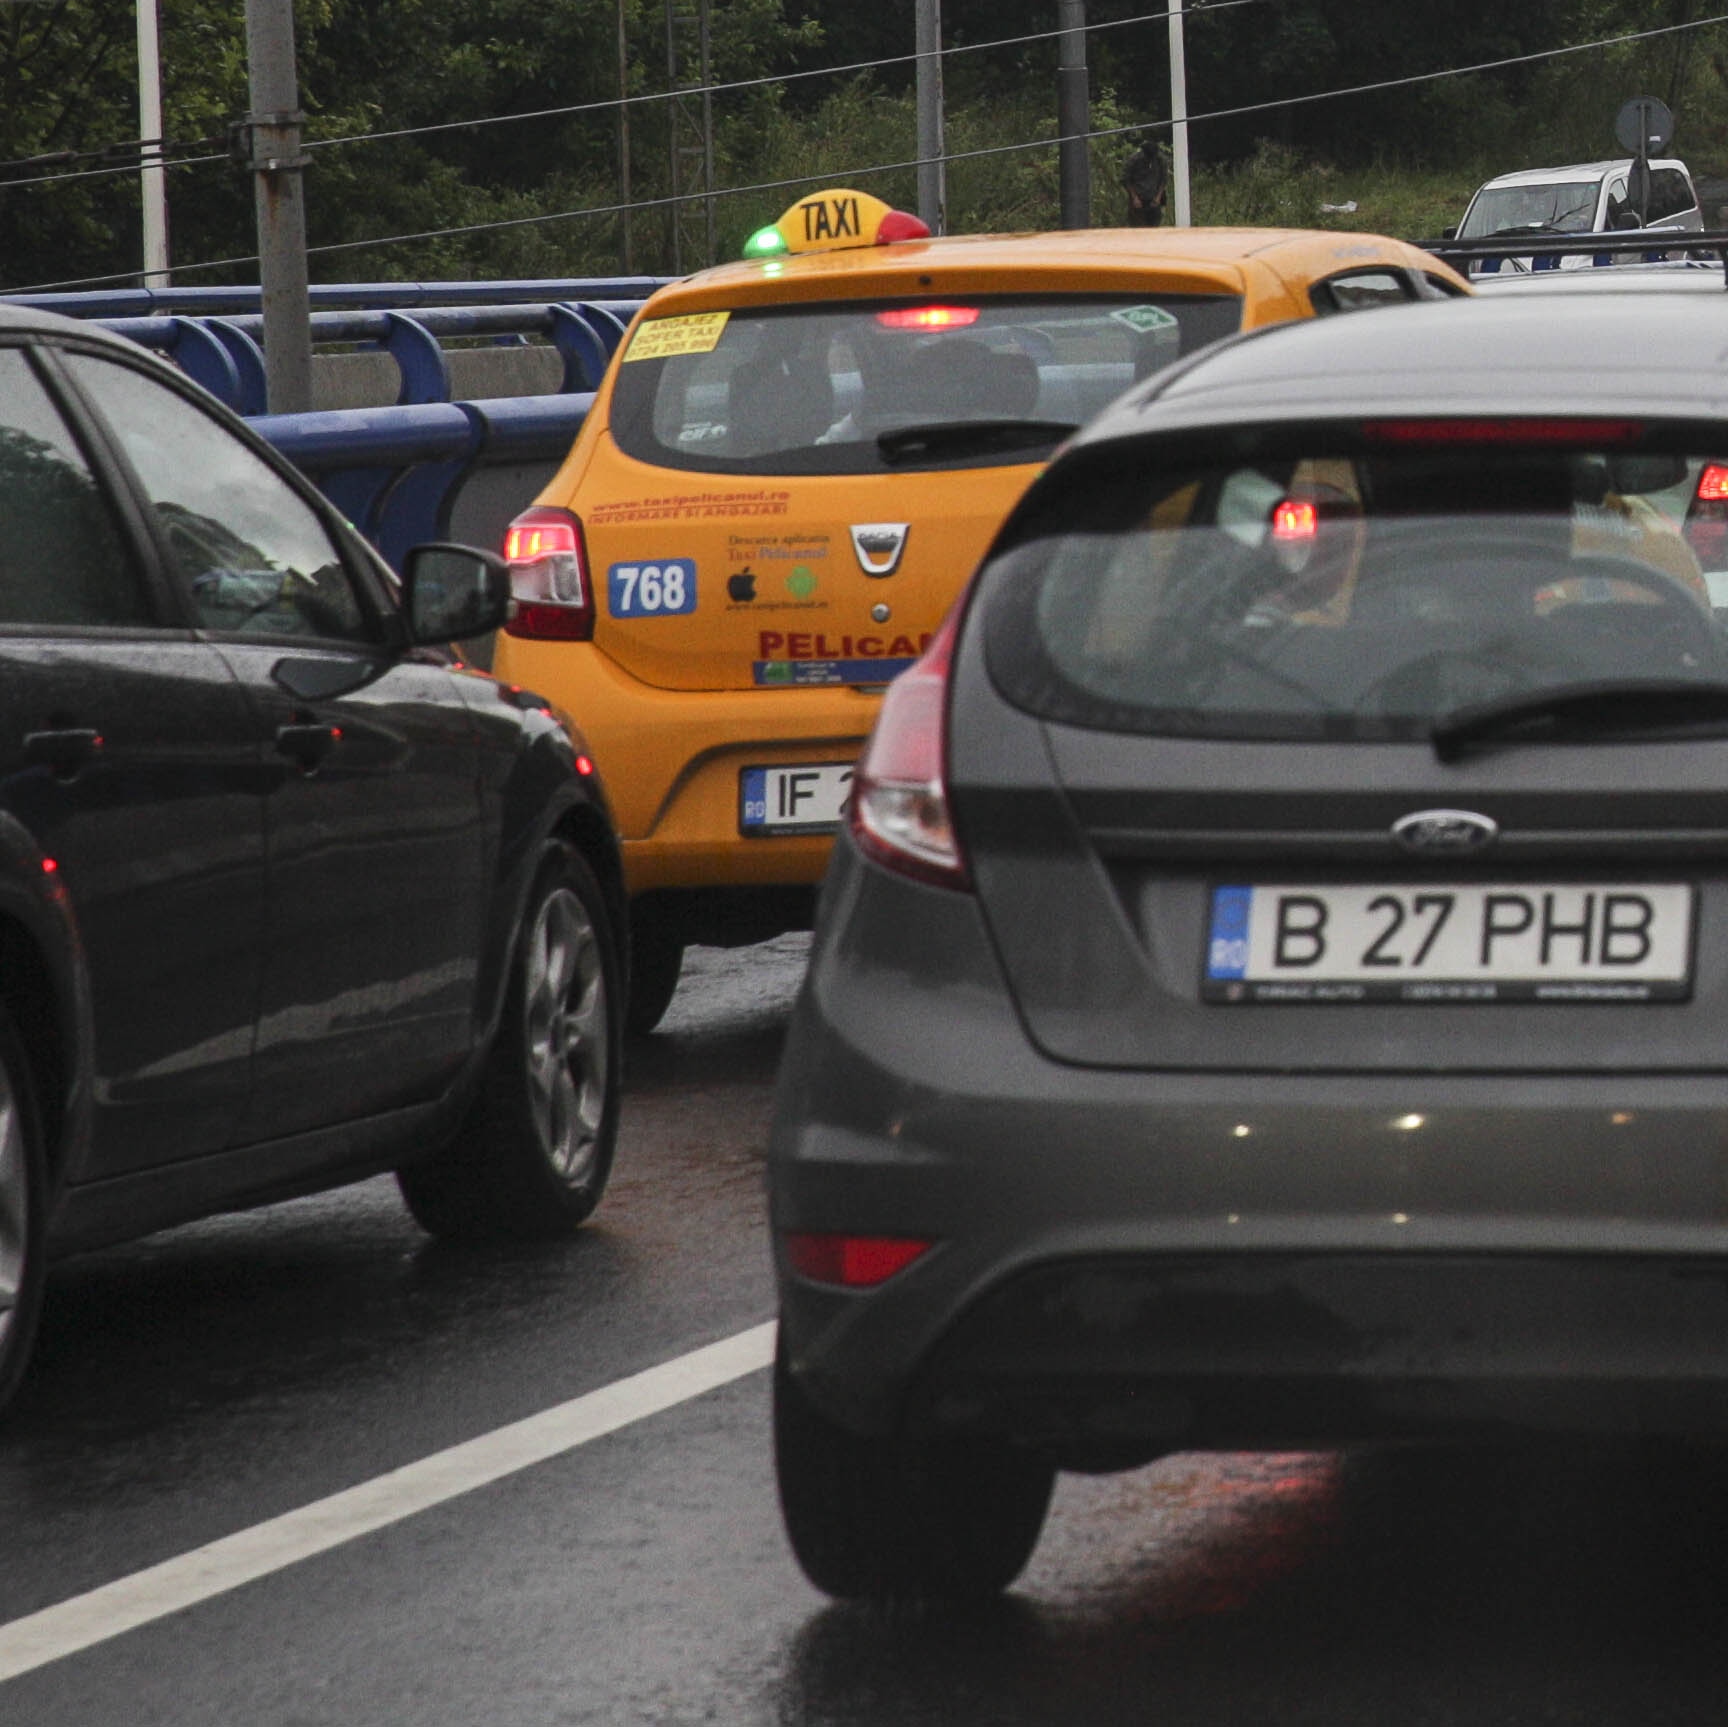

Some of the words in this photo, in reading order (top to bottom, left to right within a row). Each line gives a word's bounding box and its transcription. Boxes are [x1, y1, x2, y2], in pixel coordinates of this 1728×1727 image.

[800, 198, 860, 241] TAXI
[616, 565, 686, 611] 768
[779, 773, 820, 818] IF
[1274, 895, 1329, 968] B
[1360, 893, 1455, 967] 27
[1480, 892, 1655, 967] PHB
